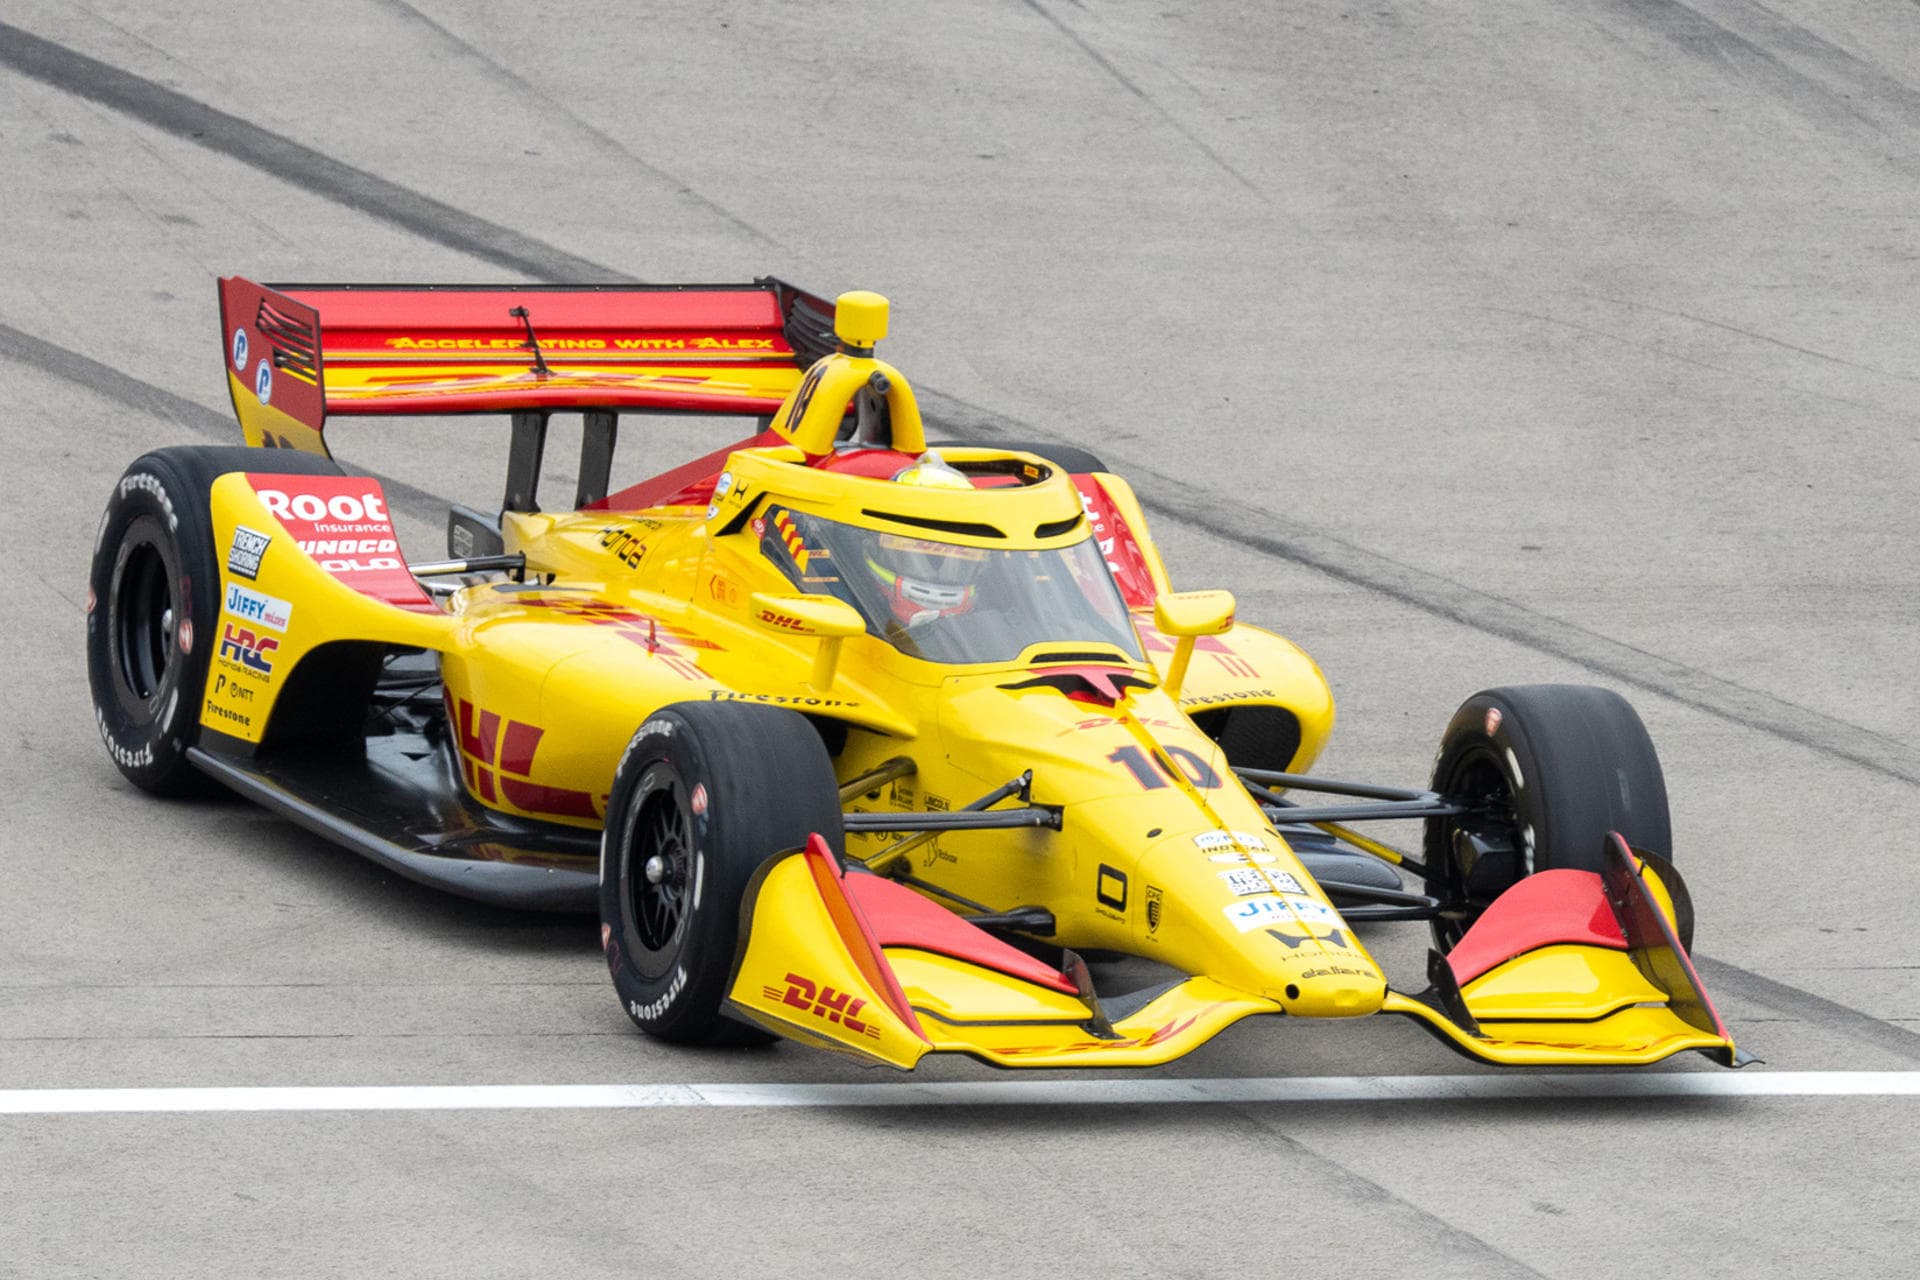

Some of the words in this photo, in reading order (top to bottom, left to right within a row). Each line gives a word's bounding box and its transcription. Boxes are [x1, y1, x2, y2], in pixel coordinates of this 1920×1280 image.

[615, 339, 685, 349] WITH
[698, 337, 774, 349] ALEX
[256, 489, 388, 522] Root
[314, 522, 391, 533] Insurance
[228, 588, 266, 620] JIFFY
[760, 609, 804, 631] DHL
[220, 623, 279, 673] HRC
[707, 690, 863, 708] Firestone
[1180, 688, 1276, 705] irestone
[207, 699, 251, 727] Firestone
[443, 683, 603, 821] HL
[1105, 744, 1223, 791] 10
[630, 965, 688, 1021] Firestone
[782, 972, 868, 1034] DHL
